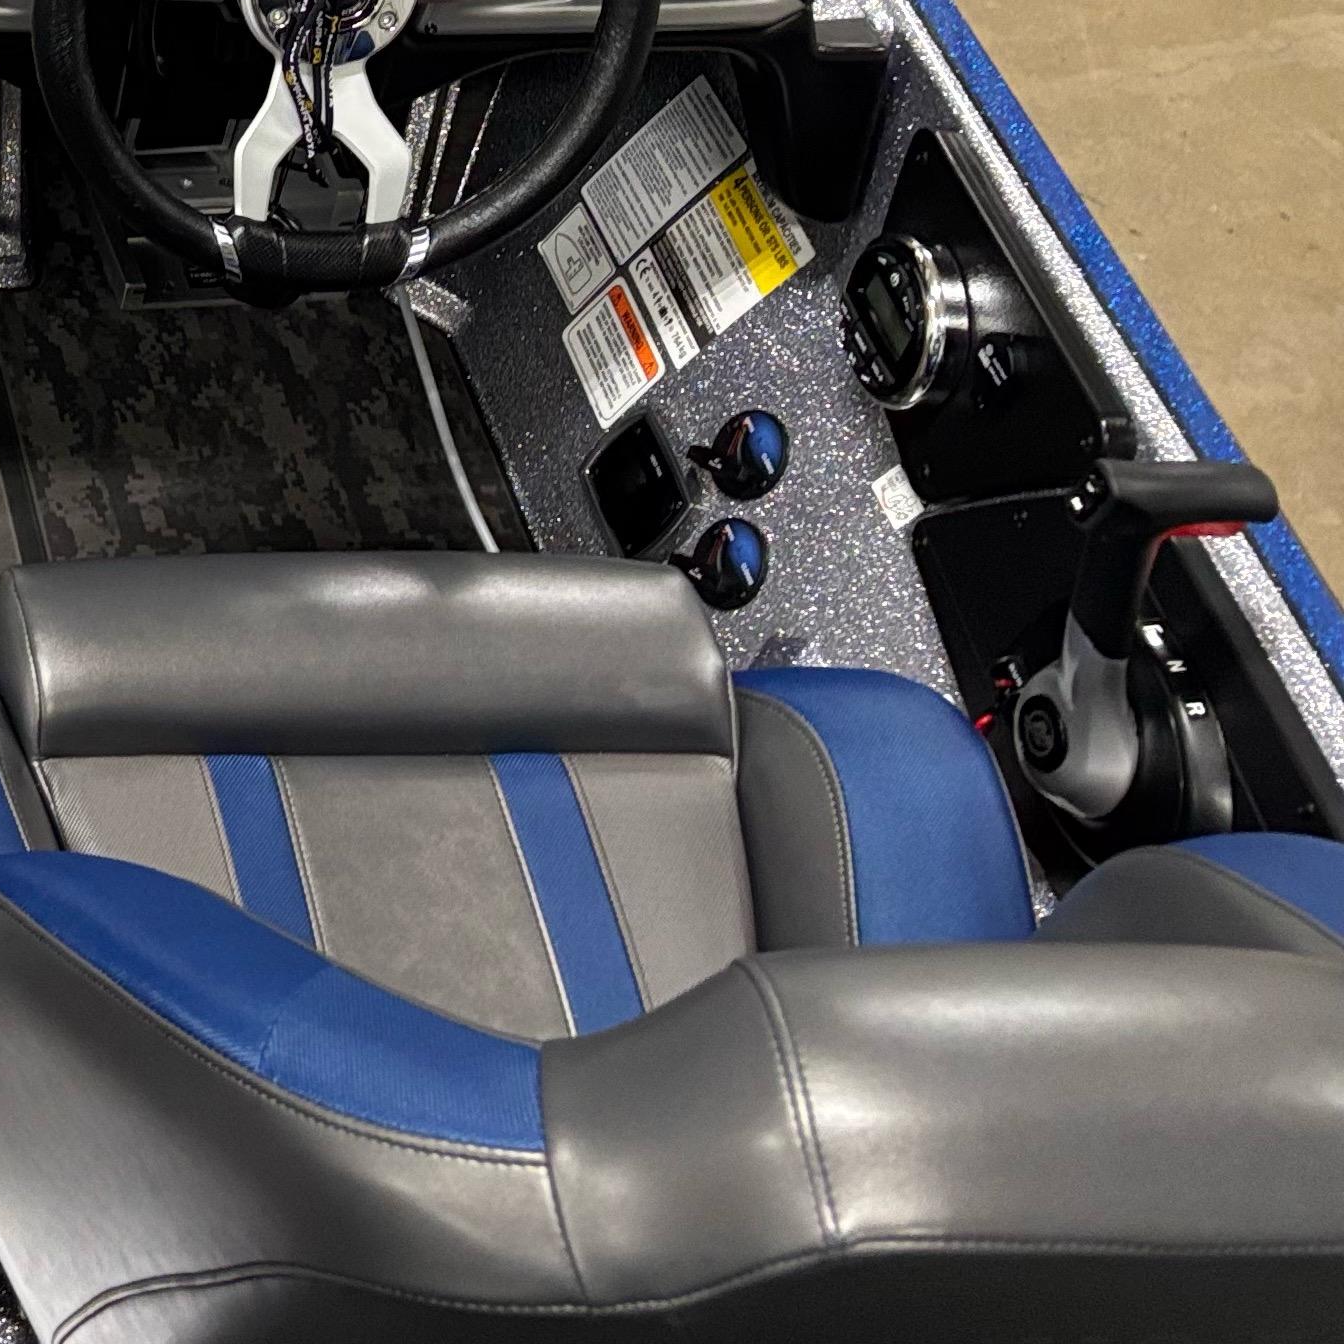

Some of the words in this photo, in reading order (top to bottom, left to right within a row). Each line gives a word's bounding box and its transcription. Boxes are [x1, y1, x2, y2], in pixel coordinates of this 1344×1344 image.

[734, 175, 748, 190] 4
[739, 185, 764, 224] PERSONS
[759, 221, 771, 236] OR
[772, 207, 802, 256] CAPACITIES
[774, 250, 790, 269] LBS
[622, 309, 645, 352] WARNING
[1185, 701, 1206, 716] R
